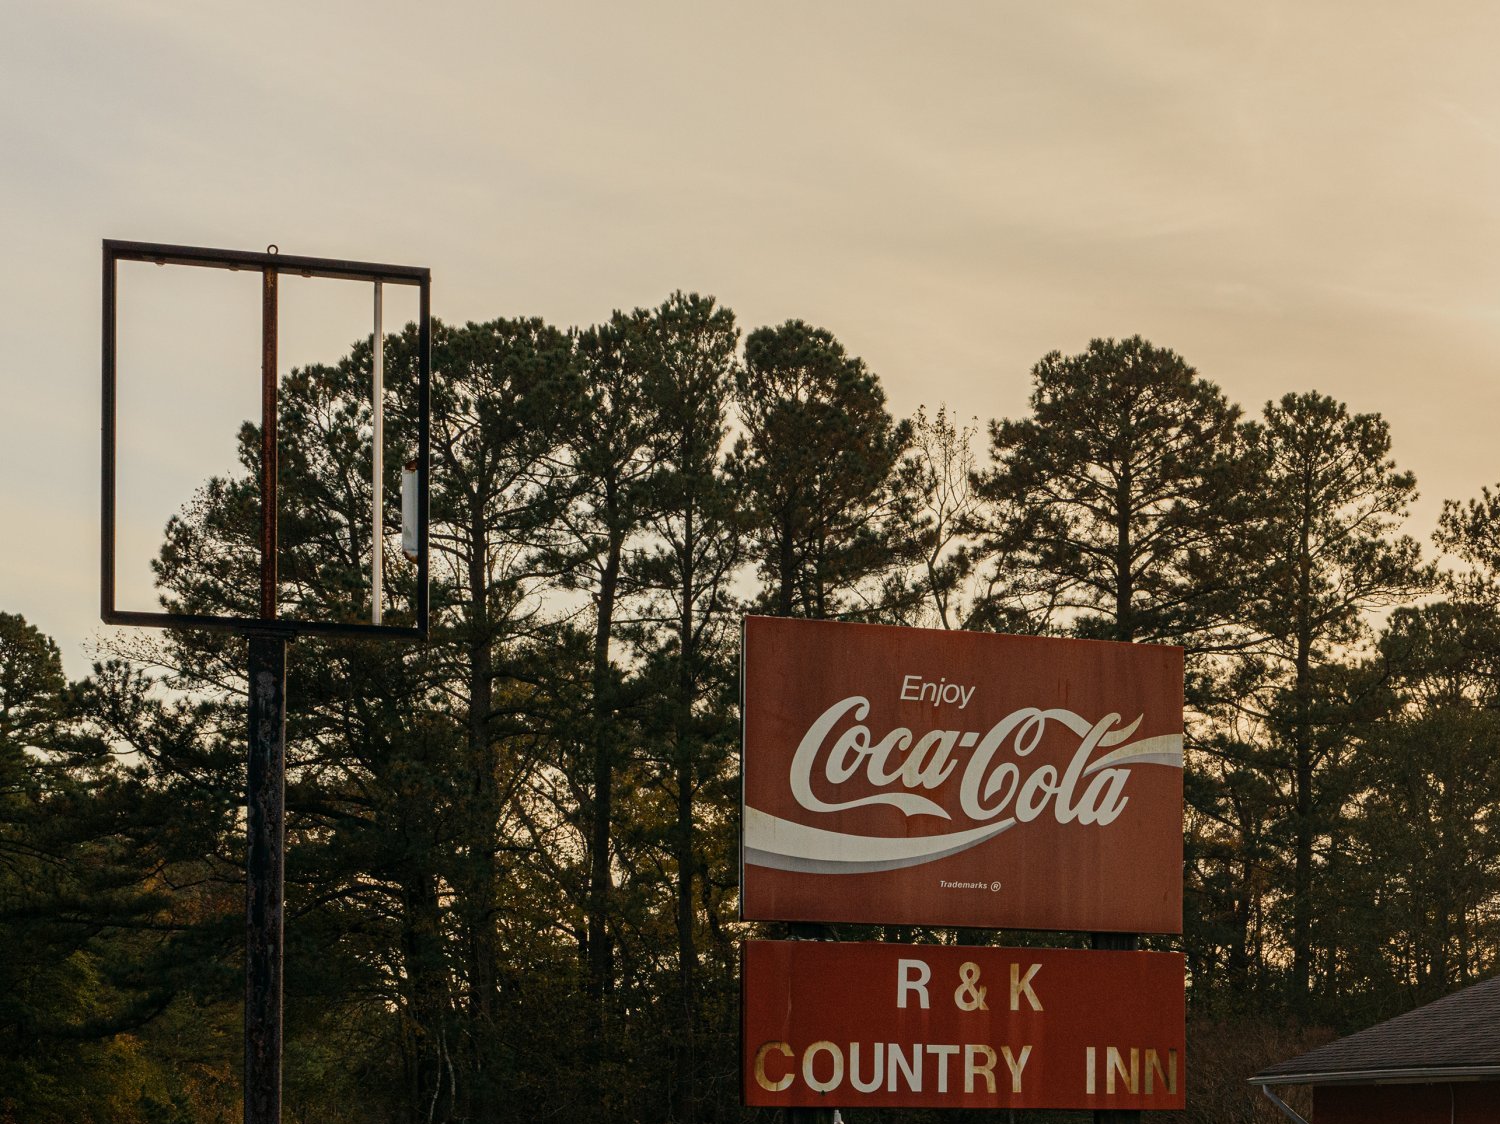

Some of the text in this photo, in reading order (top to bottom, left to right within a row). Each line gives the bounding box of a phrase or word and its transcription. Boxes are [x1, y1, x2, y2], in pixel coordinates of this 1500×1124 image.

[900, 675, 976, 709] Enjoy
[790, 695, 1144, 827] Coca-Cola
[940, 880, 988, 890] Trademarks
[896, 958, 1044, 1012] R & K
[754, 1040, 1178, 1095] COUNTRY INN
